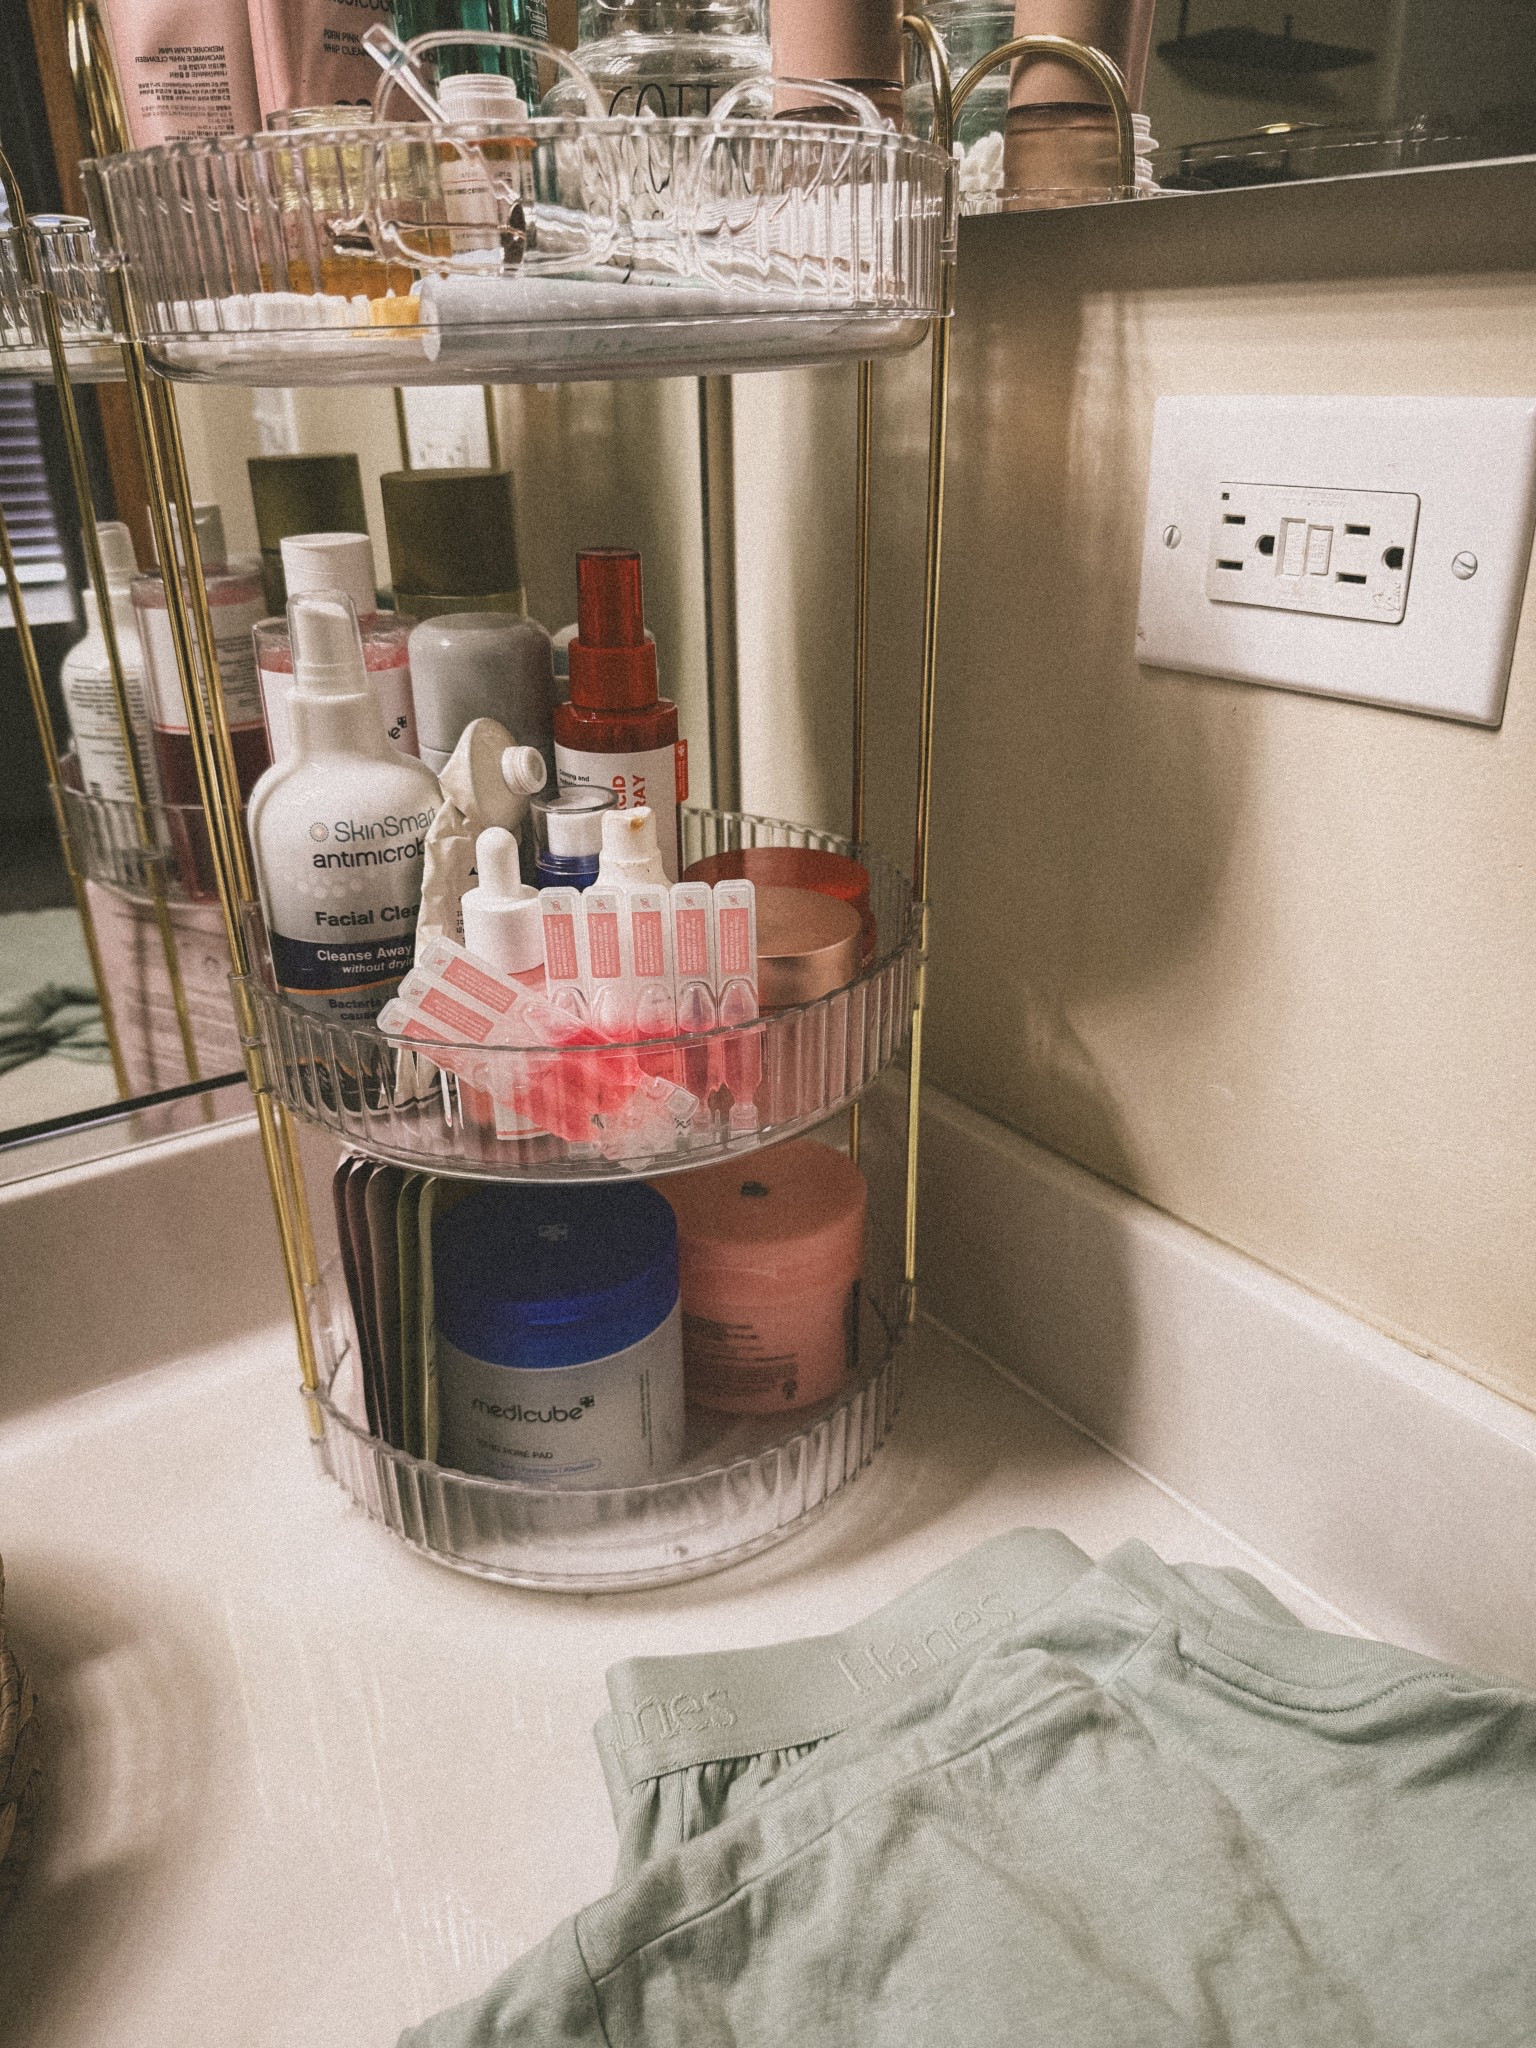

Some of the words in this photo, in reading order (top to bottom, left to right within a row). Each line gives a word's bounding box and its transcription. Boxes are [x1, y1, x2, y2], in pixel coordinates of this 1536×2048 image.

[323, 43, 340, 53] WHIP
[315, 909, 374, 926] Facial
[316, 949, 373, 962] Cleanse
[376, 945, 412, 959] Away
[342, 961, 385, 974] without
[471, 1397, 583, 1423] medicube
[531, 1450, 554, 1460] PAD
[832, 1591, 1017, 1695] Hanes
